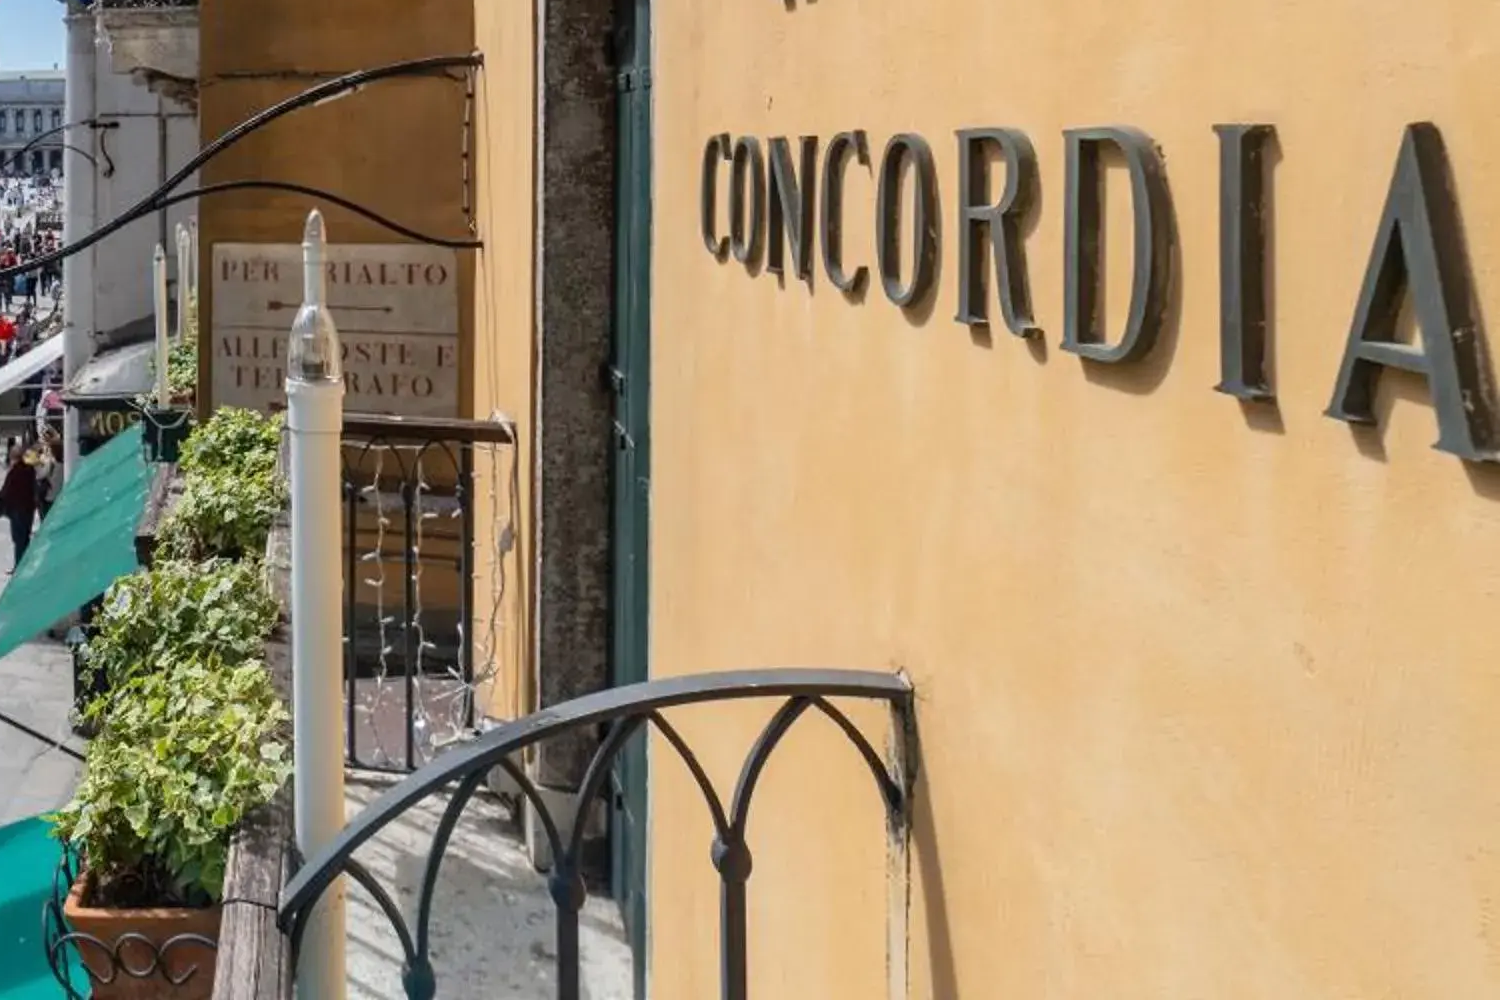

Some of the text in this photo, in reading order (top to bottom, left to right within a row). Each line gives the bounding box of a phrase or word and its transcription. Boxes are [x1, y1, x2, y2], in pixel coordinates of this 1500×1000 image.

[221, 260, 448, 286] PER RIALTO
[701, 121, 1500, 463] CONCORDIA
[341, 341, 417, 366] STE
[436, 345, 455, 367] E
[229, 364, 434, 397] TELRAFO
